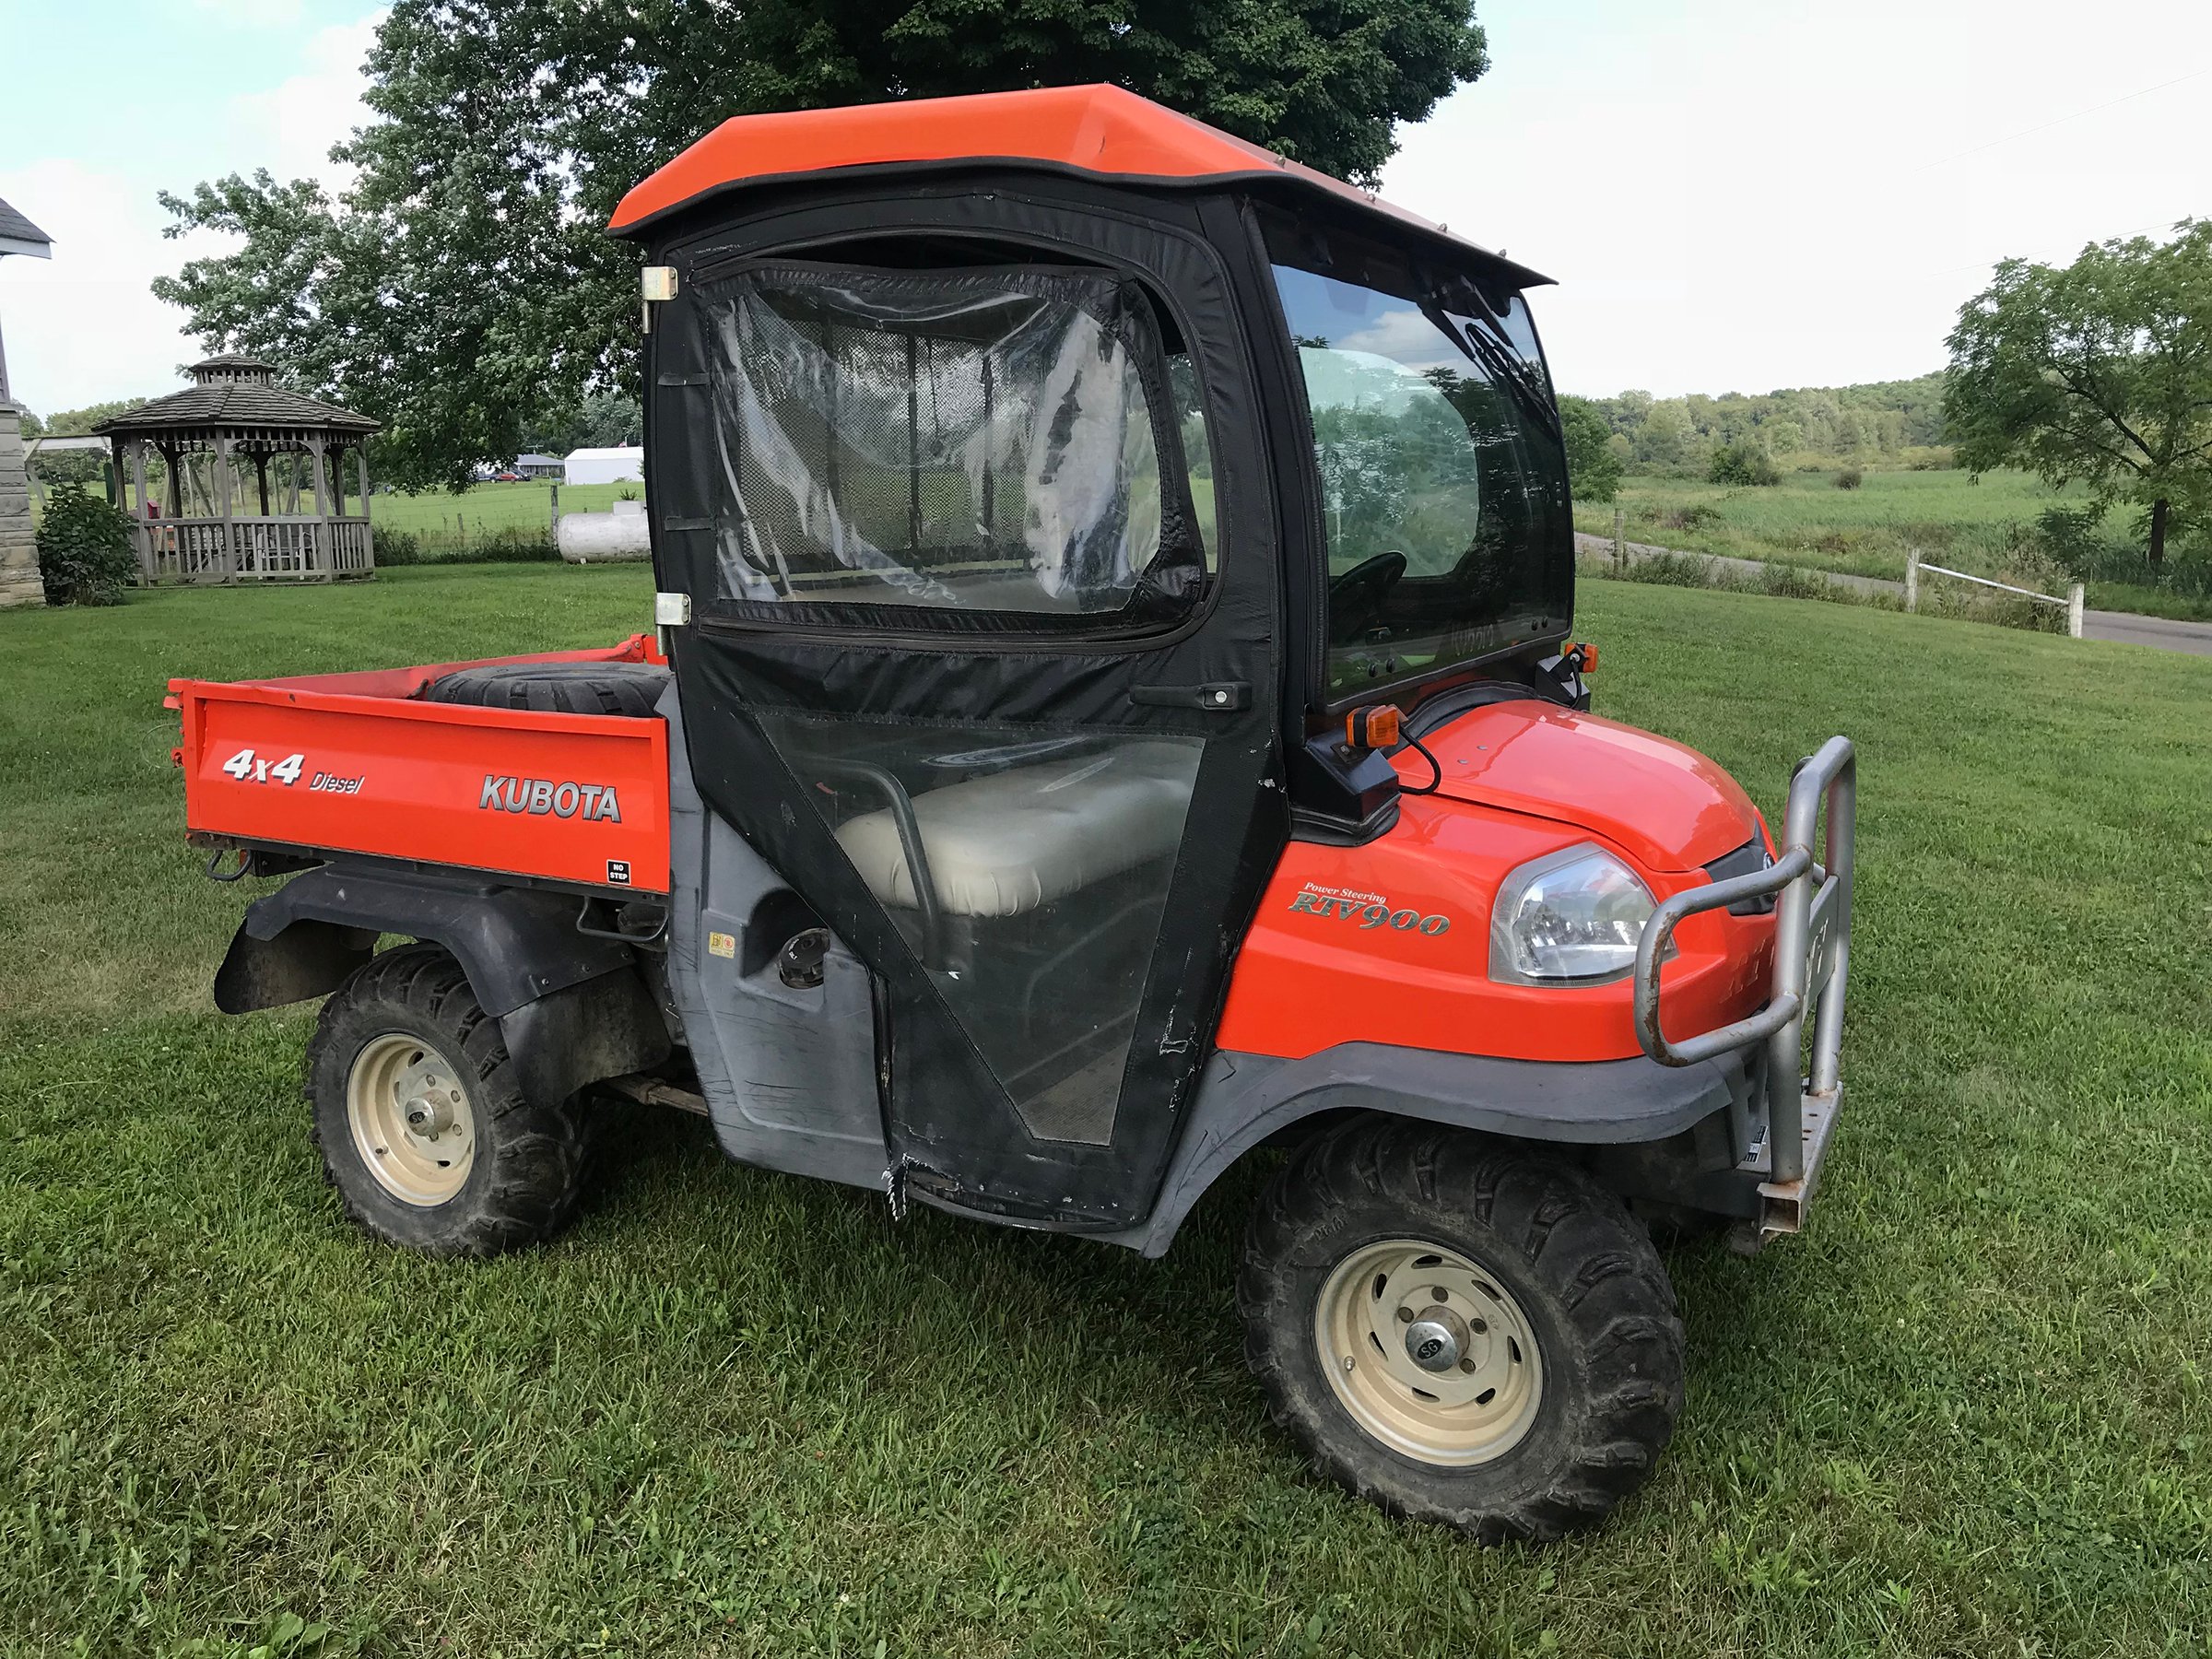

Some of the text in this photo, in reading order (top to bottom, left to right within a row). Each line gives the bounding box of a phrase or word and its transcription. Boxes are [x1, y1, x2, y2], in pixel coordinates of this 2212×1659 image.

[222, 748, 365, 794] 4x4 Diesel
[479, 775, 622, 824] KUBOTA
[609, 872, 628, 880] STEP
[1304, 882, 1386, 905] Power Steering
[1288, 891, 1451, 936] RTV900
[1421, 1342, 1438, 1358] SG
